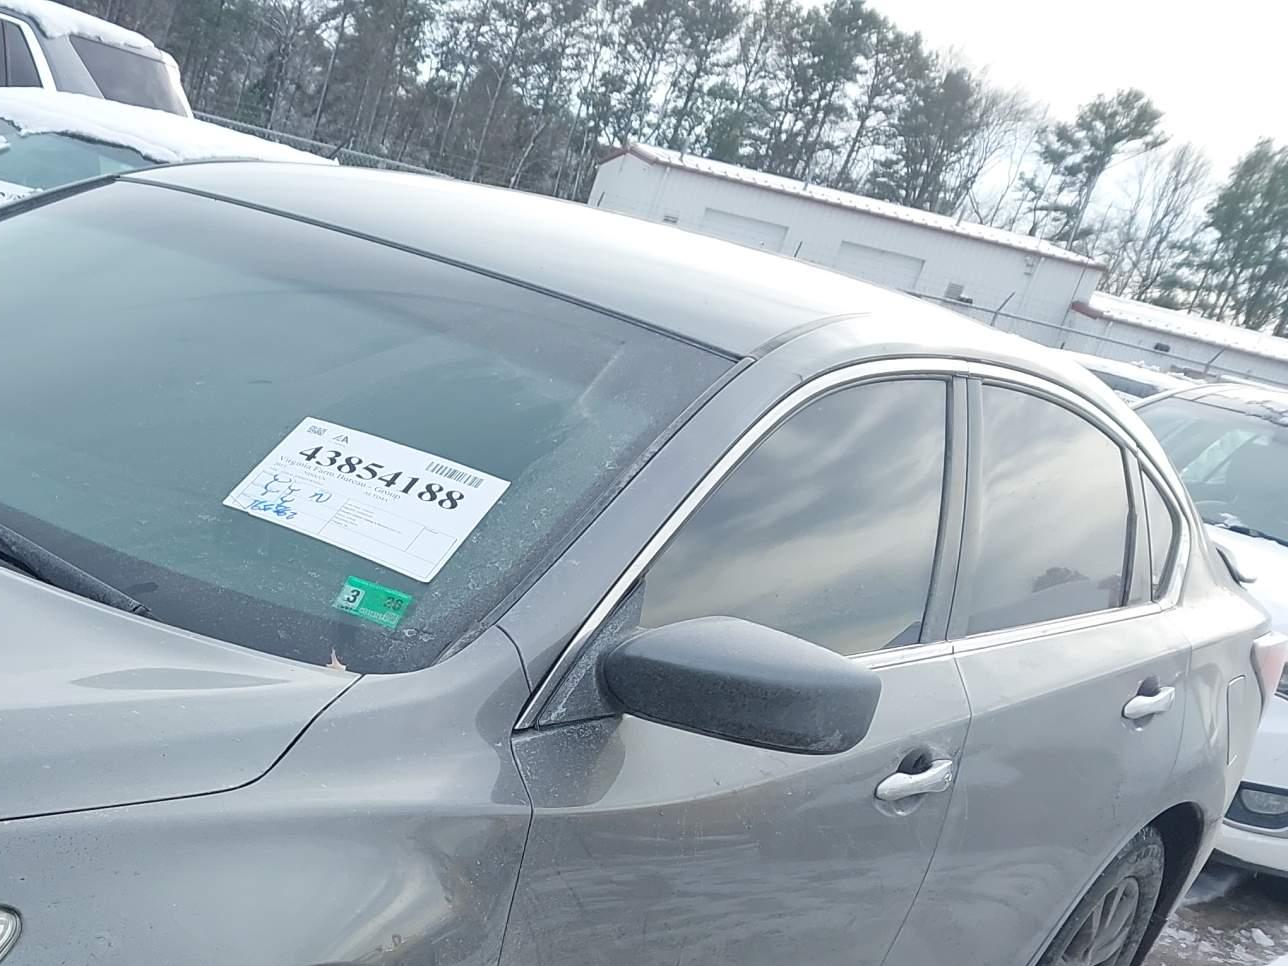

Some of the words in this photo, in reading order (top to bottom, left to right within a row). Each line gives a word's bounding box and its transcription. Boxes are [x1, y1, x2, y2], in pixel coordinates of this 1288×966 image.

[280, 455, 312, 470] Virginia
[313, 466, 336, 478] Farm
[336, 473, 367, 488] Bureau
[374, 486, 401, 501] Group
[298, 446, 465, 510] 43854188
[346, 589, 361, 603] 3
